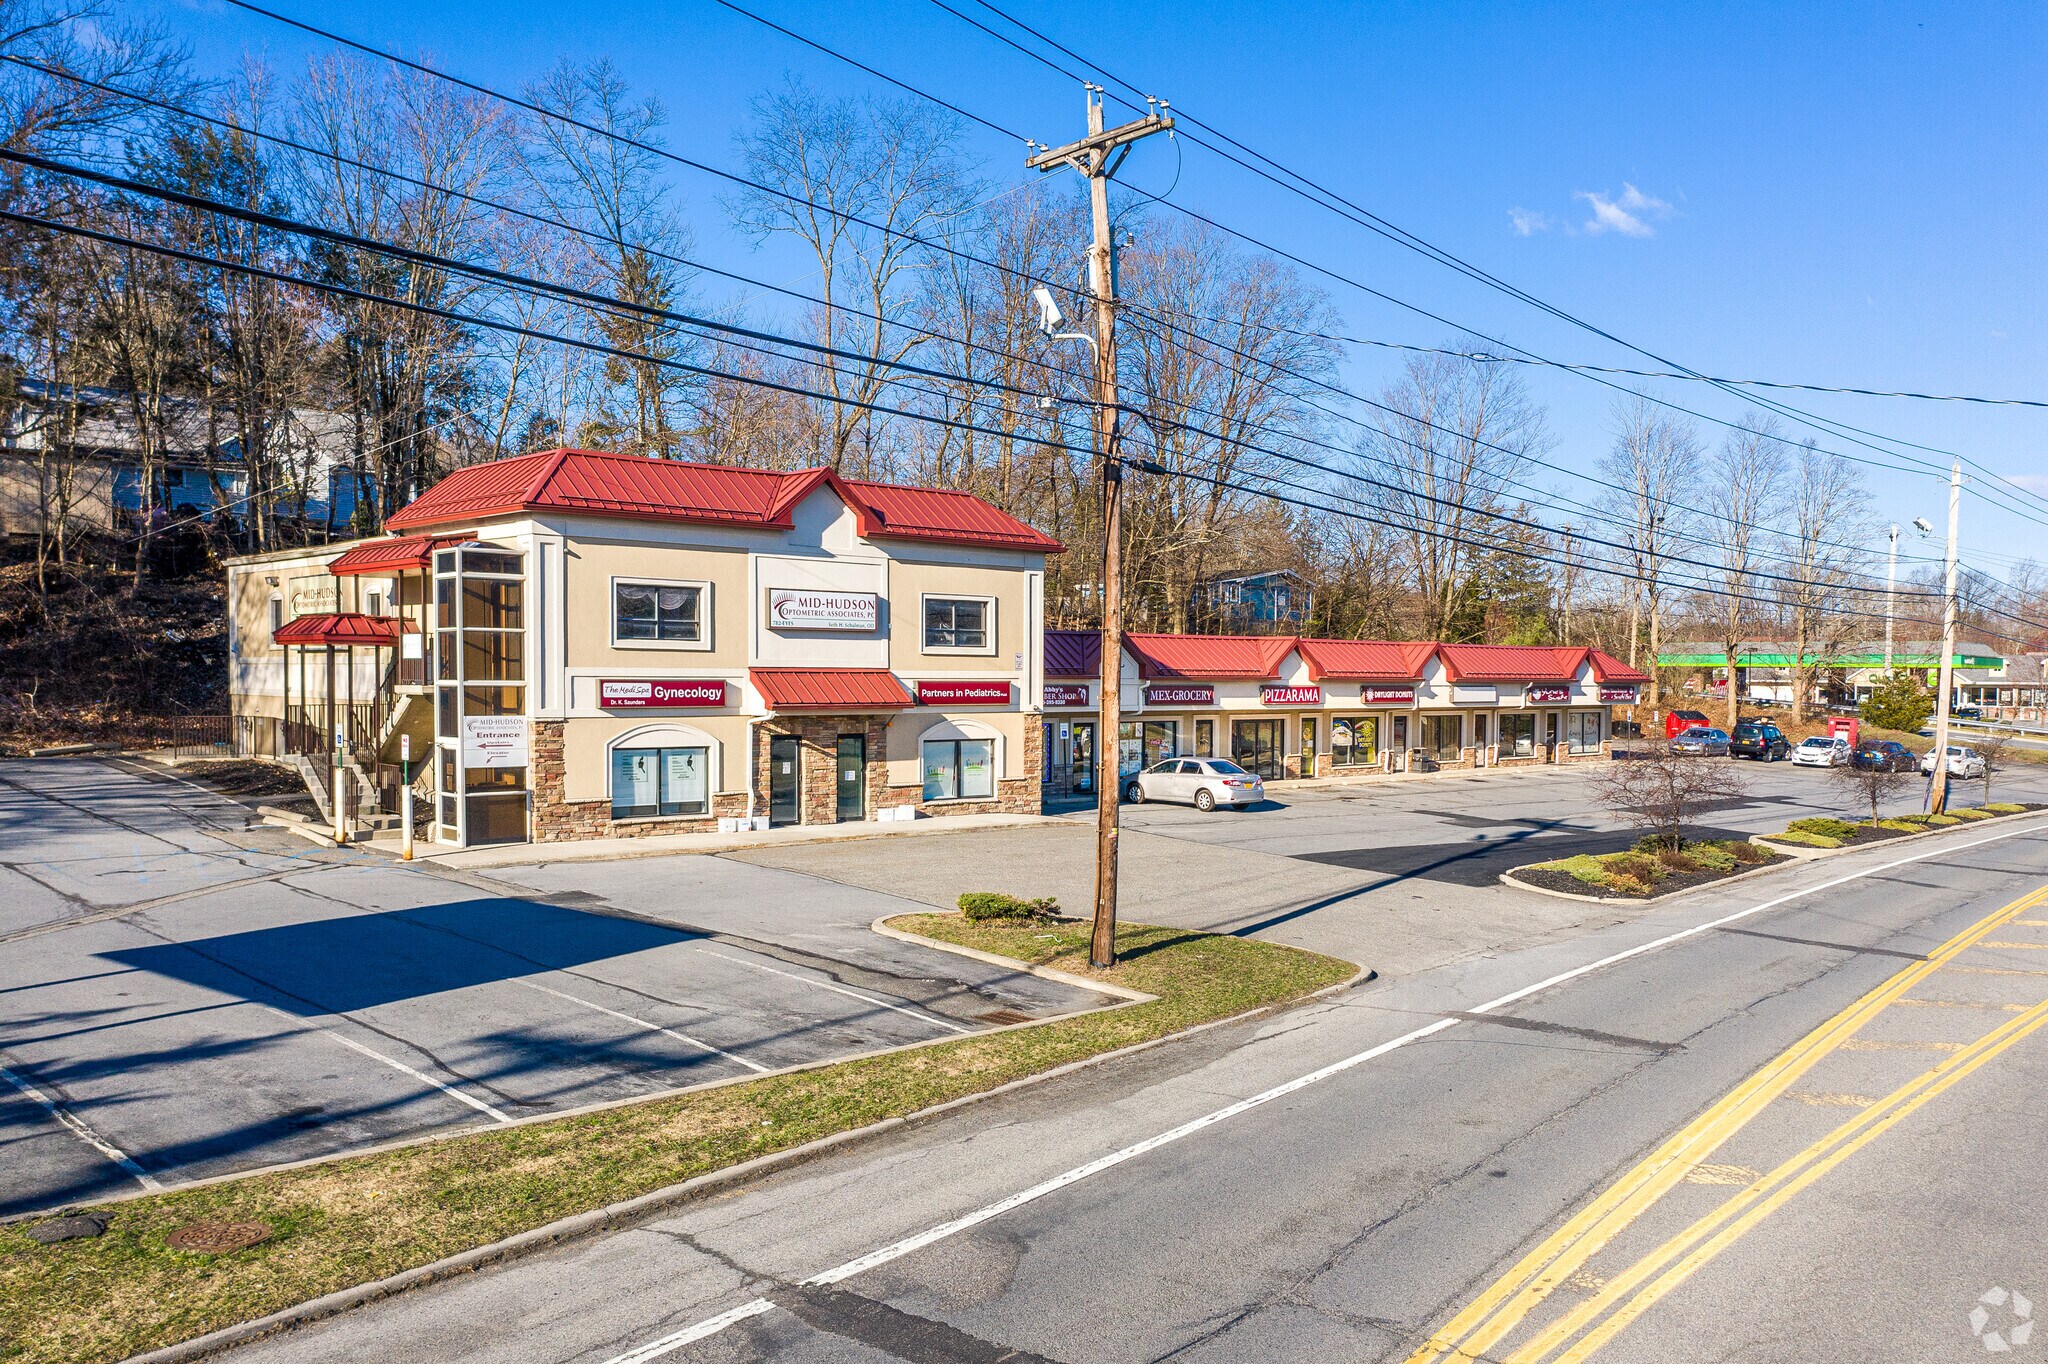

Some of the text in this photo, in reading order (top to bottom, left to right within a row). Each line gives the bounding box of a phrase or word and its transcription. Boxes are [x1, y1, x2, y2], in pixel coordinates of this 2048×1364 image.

[798, 597, 875, 610] MID-HUDSON
[782, 607, 825, 617] OPTOMETRIC
[654, 686, 722, 700] Gynecology
[921, 688, 954, 697] Partners
[955, 688, 963, 697] in
[964, 688, 1001, 697] Pediatrics
[1057, 692, 1077, 700] SHOP
[1150, 689, 1212, 701] MEX-GROCERY
[1265, 688, 1319, 702] PIZZARAMA
